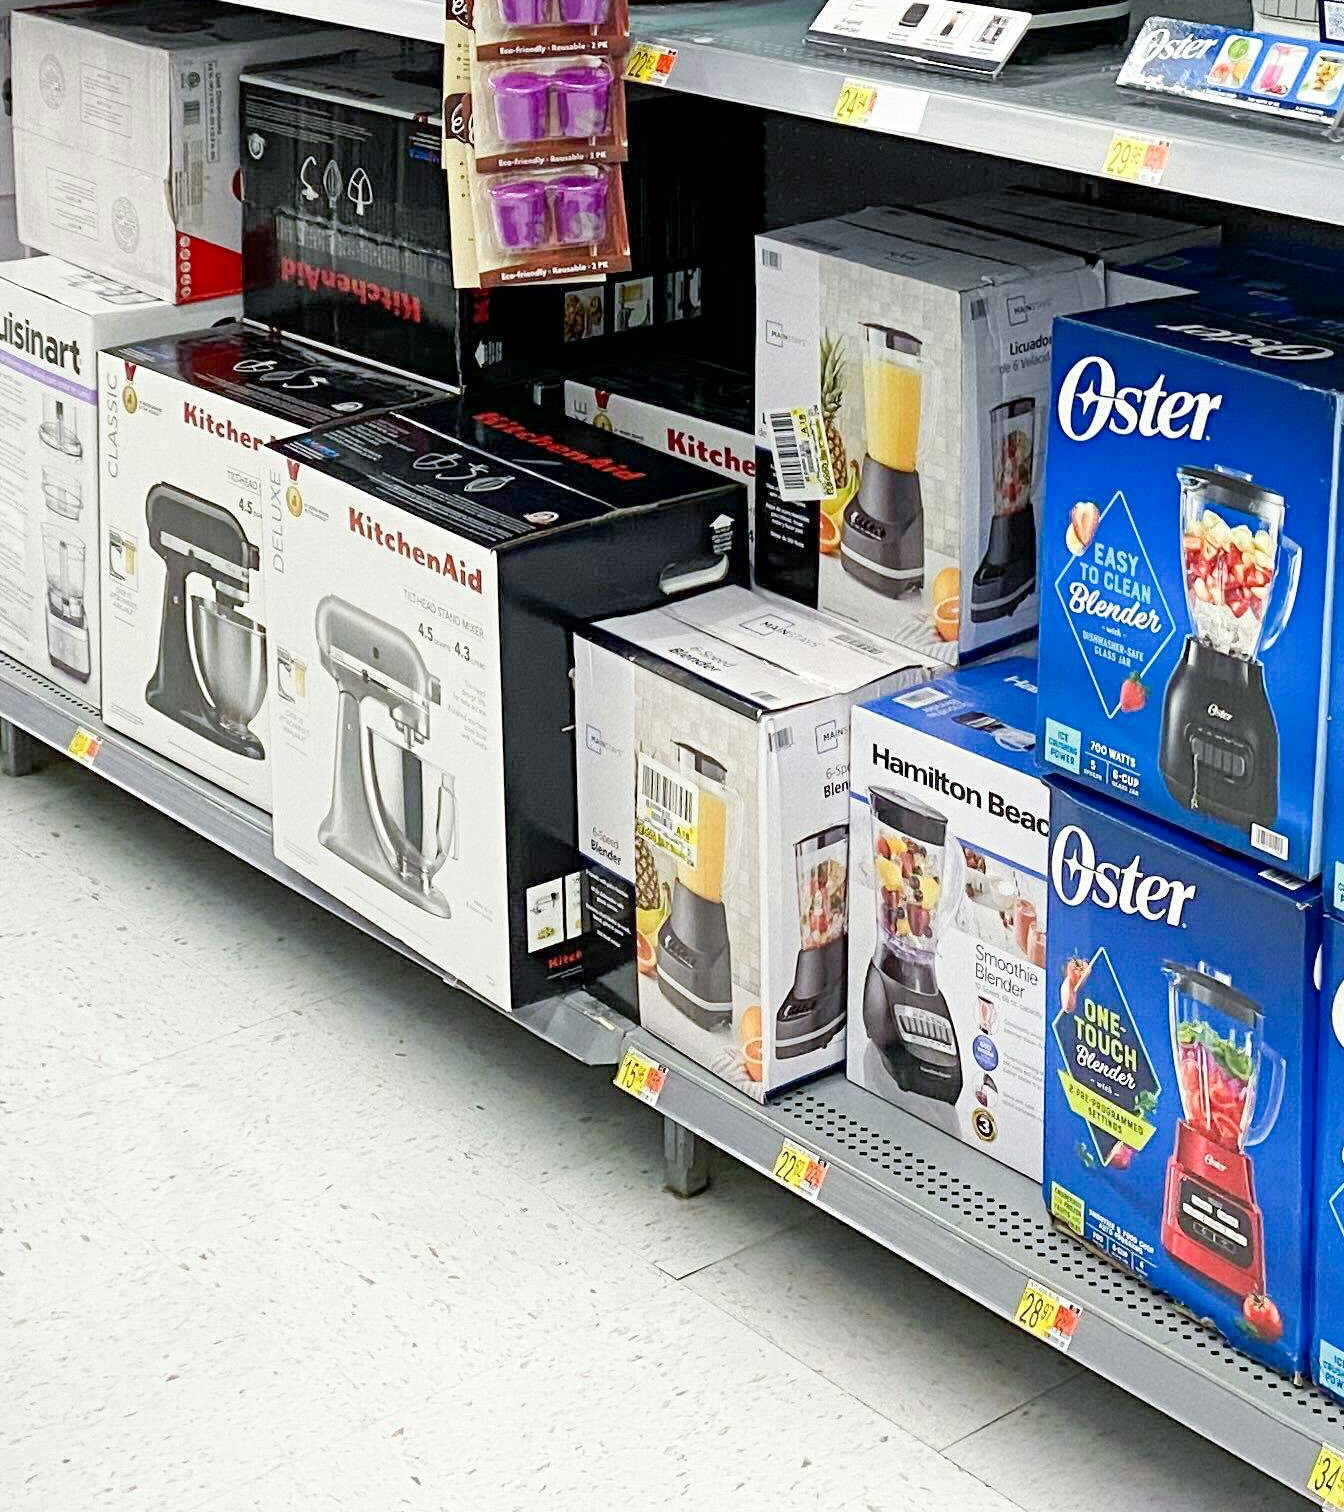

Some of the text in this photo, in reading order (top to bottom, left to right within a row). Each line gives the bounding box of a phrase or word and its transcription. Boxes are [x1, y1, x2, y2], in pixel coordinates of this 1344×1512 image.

[499, 42, 585, 55] Eco-friendly Reusable
[1139, 29, 1218, 66] Oster
[498, 152, 585, 167] Eco-friendly Reusable
[280, 256, 424, 325] KitchenAid
[501, 264, 585, 281] Eco-friendly Reusable
[1157, 323, 1335, 362] Oster
[1057, 355, 1224, 442] Oster
[107, 372, 119, 479] CLASSIC
[471, 409, 648, 483] KitchenAid
[269, 467, 283, 575] DELUXE
[348, 505, 485, 597] KitchenAid
[1094, 542, 1139, 578] EASY
[1081, 562, 1151, 606] TO CLEAN
[1068, 581, 1162, 635] Blender
[418, 622, 433, 642] 4.5
[670, 647, 722, 674] Blender
[1090, 740, 1136, 768] 700 WATTS
[871, 743, 983, 810] Hamilton
[590, 838, 622, 867] Blender
[1050, 822, 1197, 929] Oster
[975, 944, 1039, 986] Smoothie
[975, 963, 1026, 999] Blender
[1074, 1015, 1137, 1072] TOUCH
[1076, 1044, 1136, 1090] Blender
[978, 1118, 990, 1132] 3
